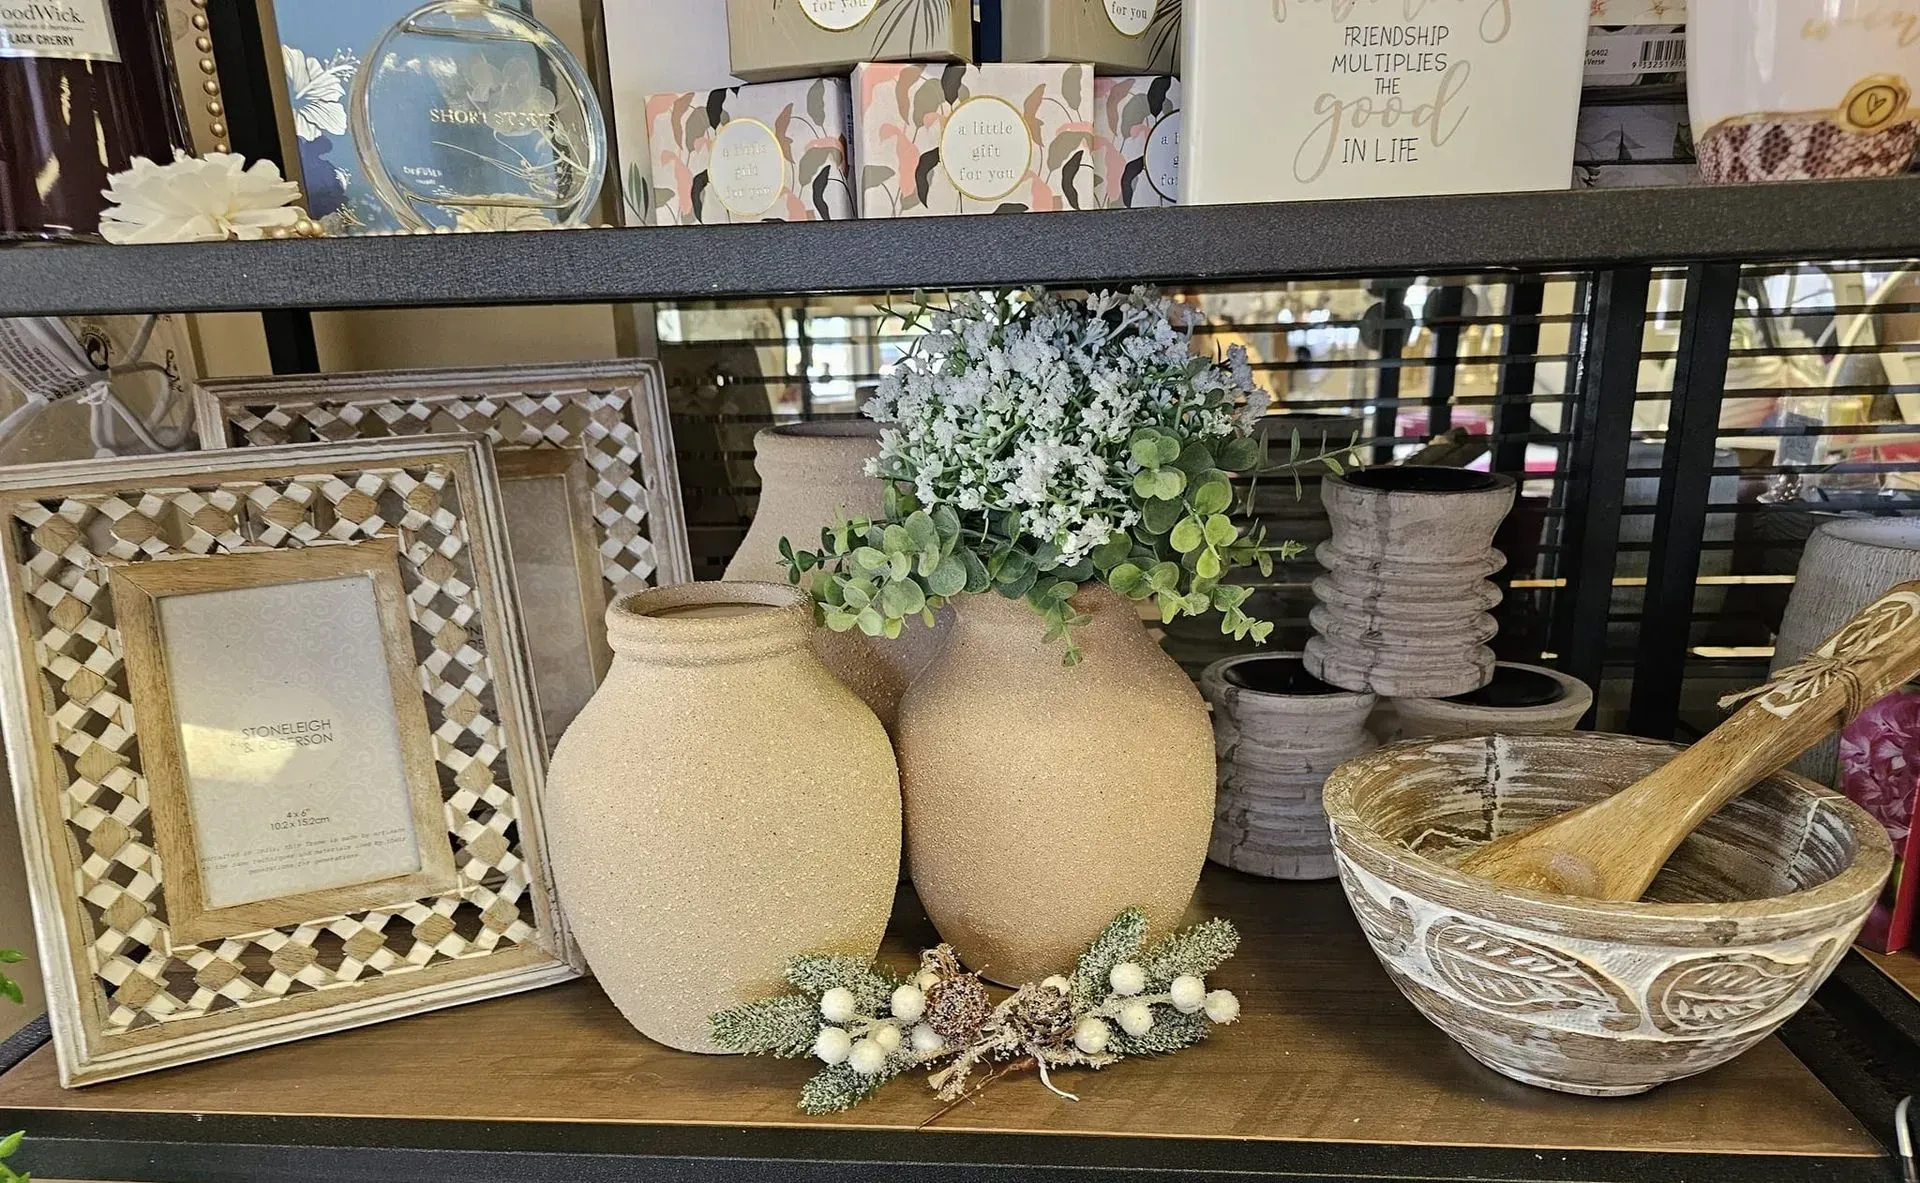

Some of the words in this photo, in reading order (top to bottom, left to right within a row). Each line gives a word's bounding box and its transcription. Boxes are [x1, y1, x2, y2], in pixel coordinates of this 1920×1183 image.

[1111, 1, 1127, 16] for
[1130, 7, 1147, 20] you
[36, 34, 74, 46] CHERRY
[1344, 26, 1450, 47] FRIENDSHIP
[1332, 53, 1448, 73] MULTIPLIES
[1375, 77, 1400, 95] THE
[958, 126, 966, 136] a
[973, 120, 1013, 135] little
[1293, 60, 1470, 184] good
[1160, 136, 1169, 145] a
[972, 144, 1001, 161] gift
[1342, 138, 1367, 164] IN
[1375, 137, 1419, 163] LIFE
[960, 167, 982, 181] for
[988, 168, 1015, 183] you
[242, 719, 332, 739] STONELEIGH
